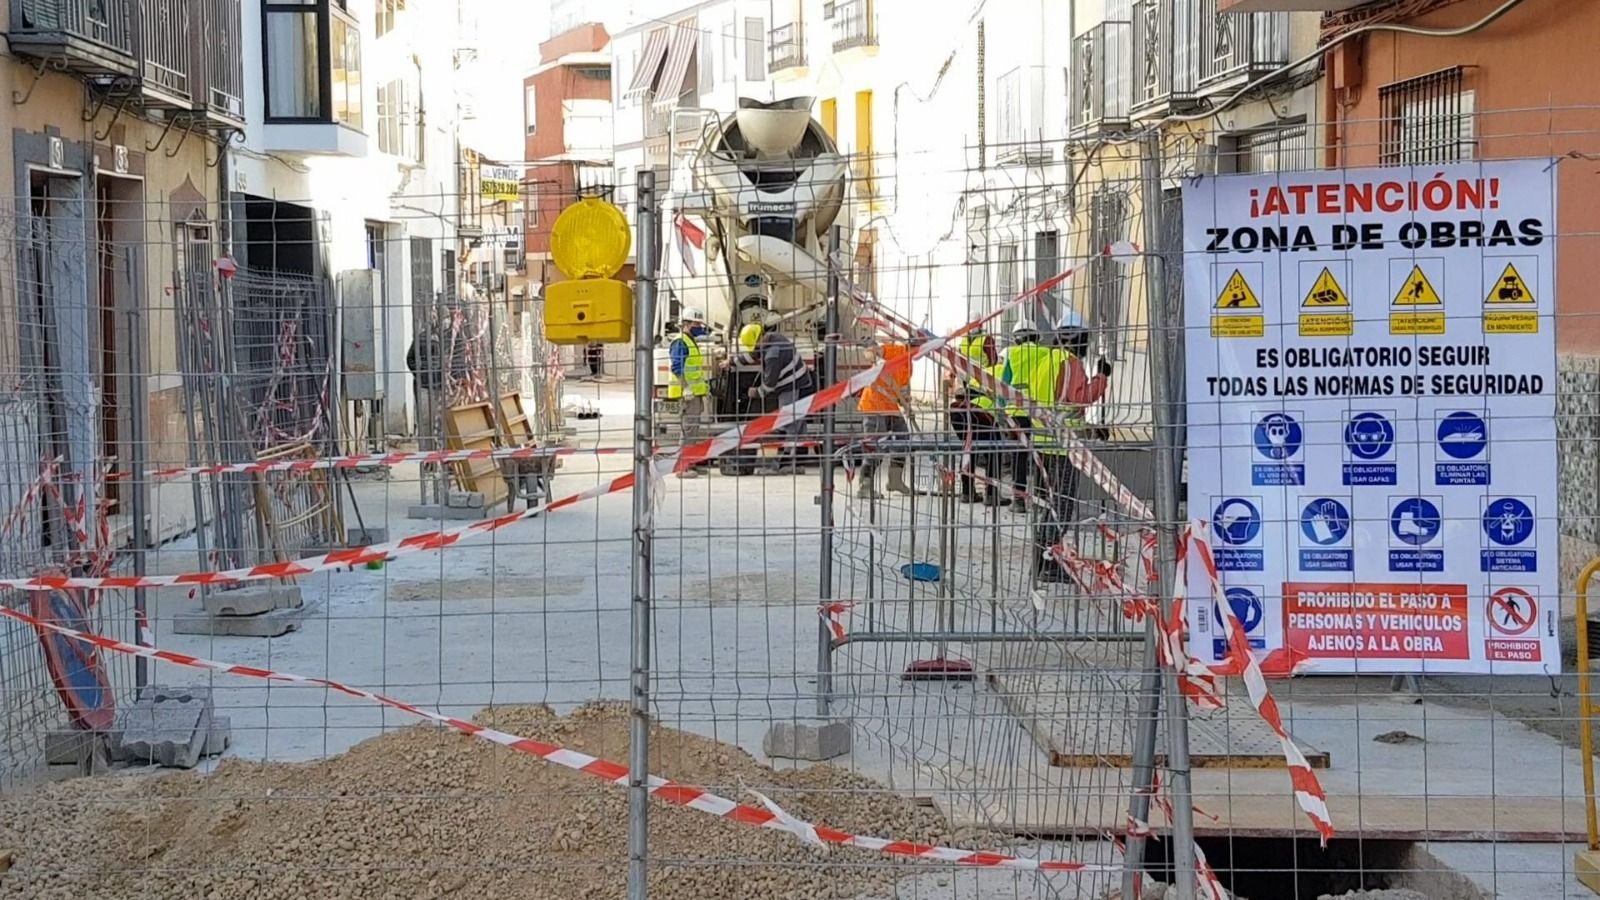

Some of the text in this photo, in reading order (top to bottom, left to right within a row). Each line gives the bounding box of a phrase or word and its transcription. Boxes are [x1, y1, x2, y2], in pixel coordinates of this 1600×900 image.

[492, 168, 519, 181] VENDE
[1250, 172, 1499, 218] ¡ATENCIÓN!
[1206, 218, 1543, 253] ZONA DE OBRAS
[1256, 346, 1490, 368] ES OBLIGATORIO SEGUIR
[1207, 374, 1543, 396] TODAS LAS NORMAS DE SEGURIDAD
[1298, 591, 1452, 609] PROHIBIDO EL PASO A
[1288, 613, 1462, 631] PERSONAS Y VEHICULOS
[1308, 635, 1444, 651] AJENOS A LA OBRA
[1487, 642, 1537, 650] PROHIBIDO
[1507, 651, 1532, 659] PASO
